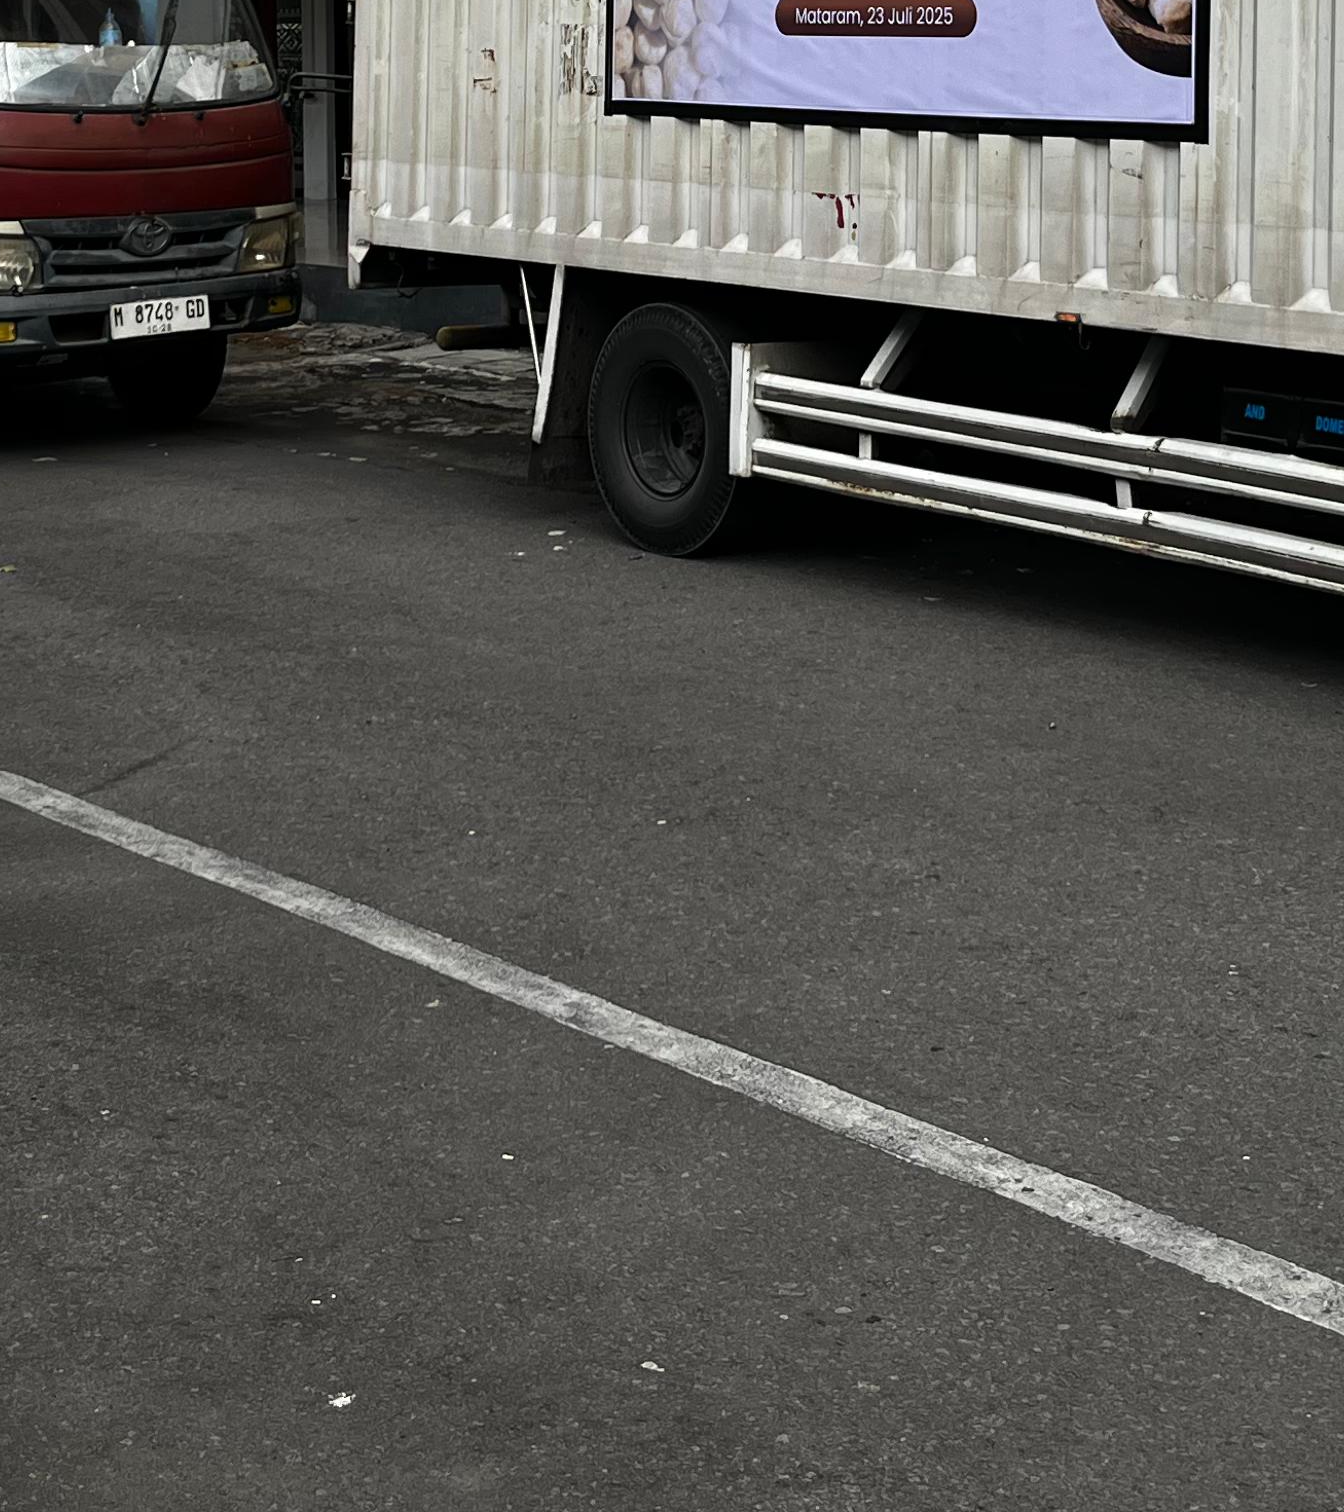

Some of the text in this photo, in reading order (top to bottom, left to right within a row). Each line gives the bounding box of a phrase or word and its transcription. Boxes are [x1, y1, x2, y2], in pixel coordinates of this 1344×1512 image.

[795, 6, 954, 28] Mataram, 23 Juli 2025
[114, 298, 205, 327] M 8748 GD
